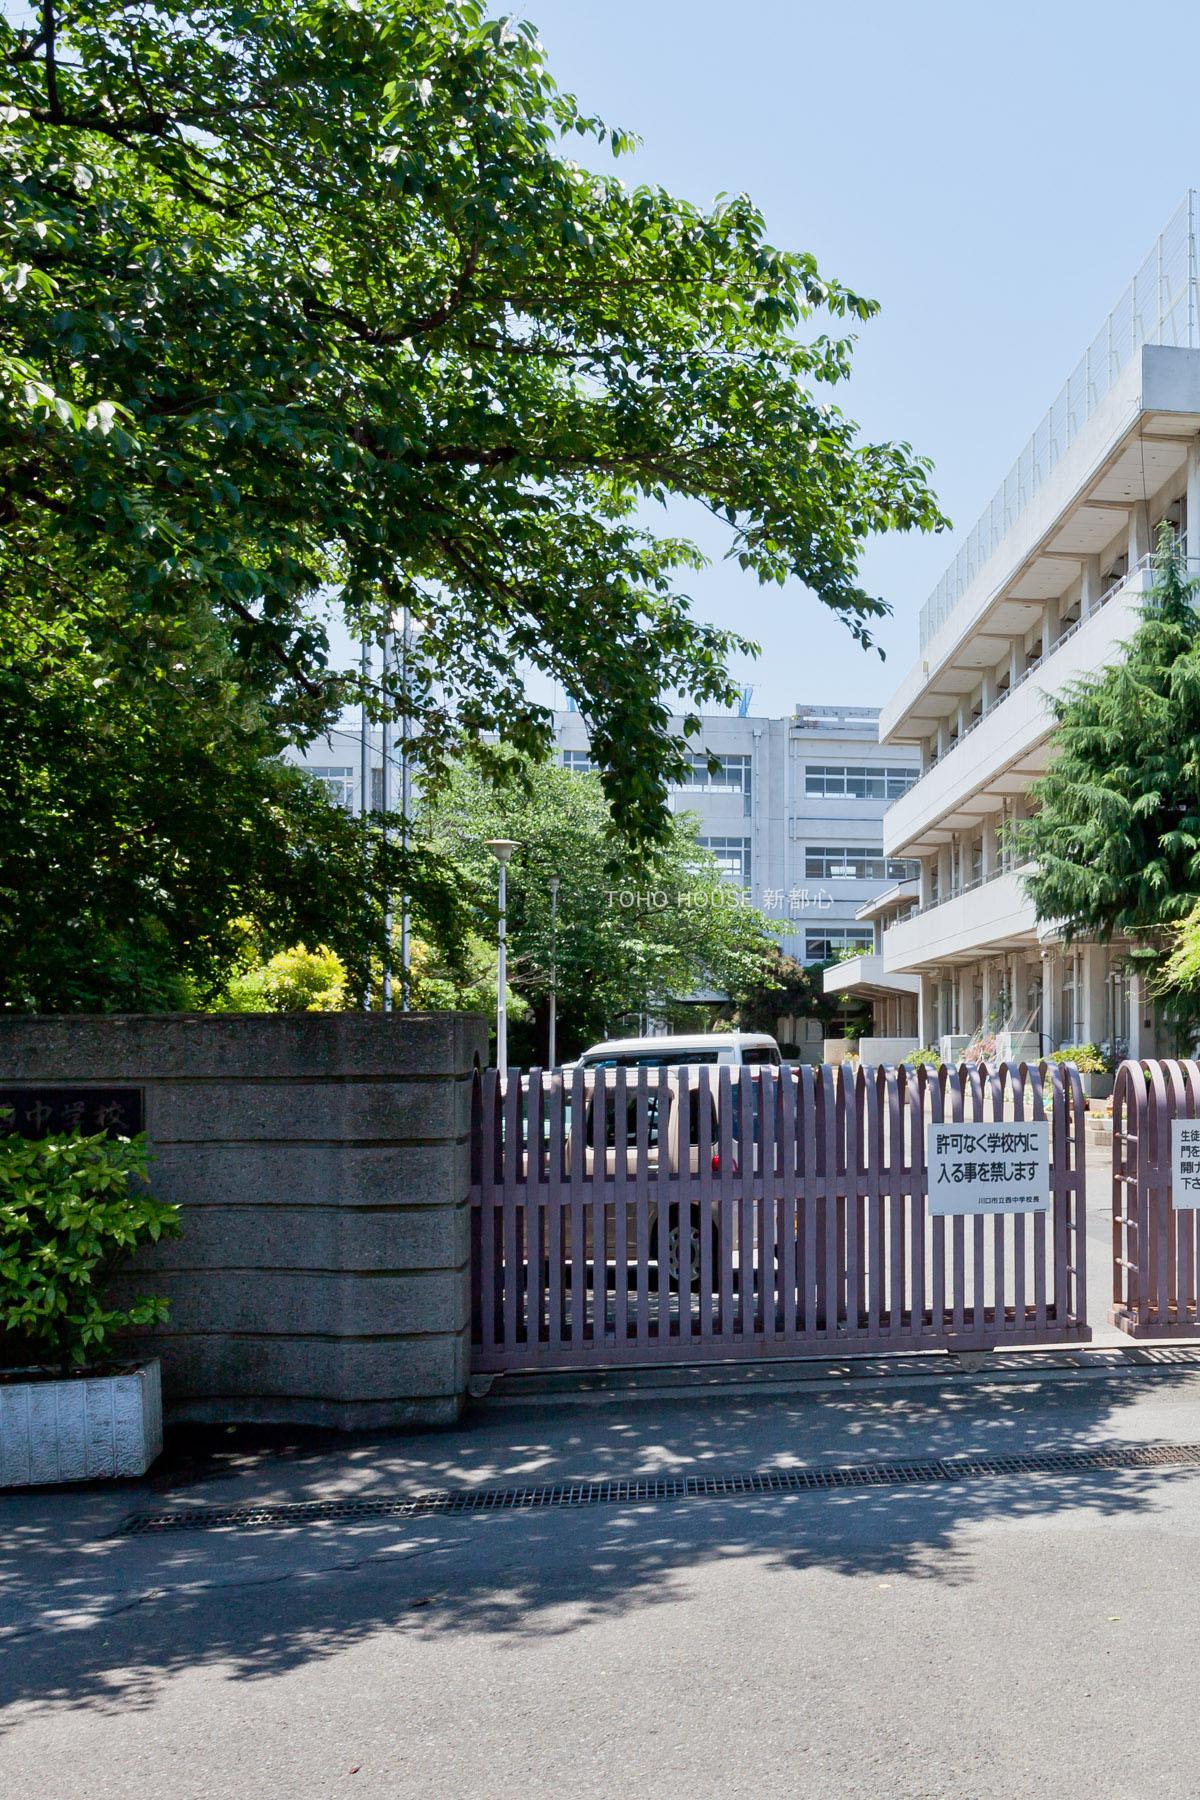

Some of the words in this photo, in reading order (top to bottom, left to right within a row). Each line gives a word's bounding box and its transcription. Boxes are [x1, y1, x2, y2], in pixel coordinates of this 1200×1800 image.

[936, 1132, 1039, 1154] 許可なく学校内に
[937, 1161, 1039, 1183] 入る事を禁じます
[978, 1195, 1040, 1205] 川口市立西中学校長
